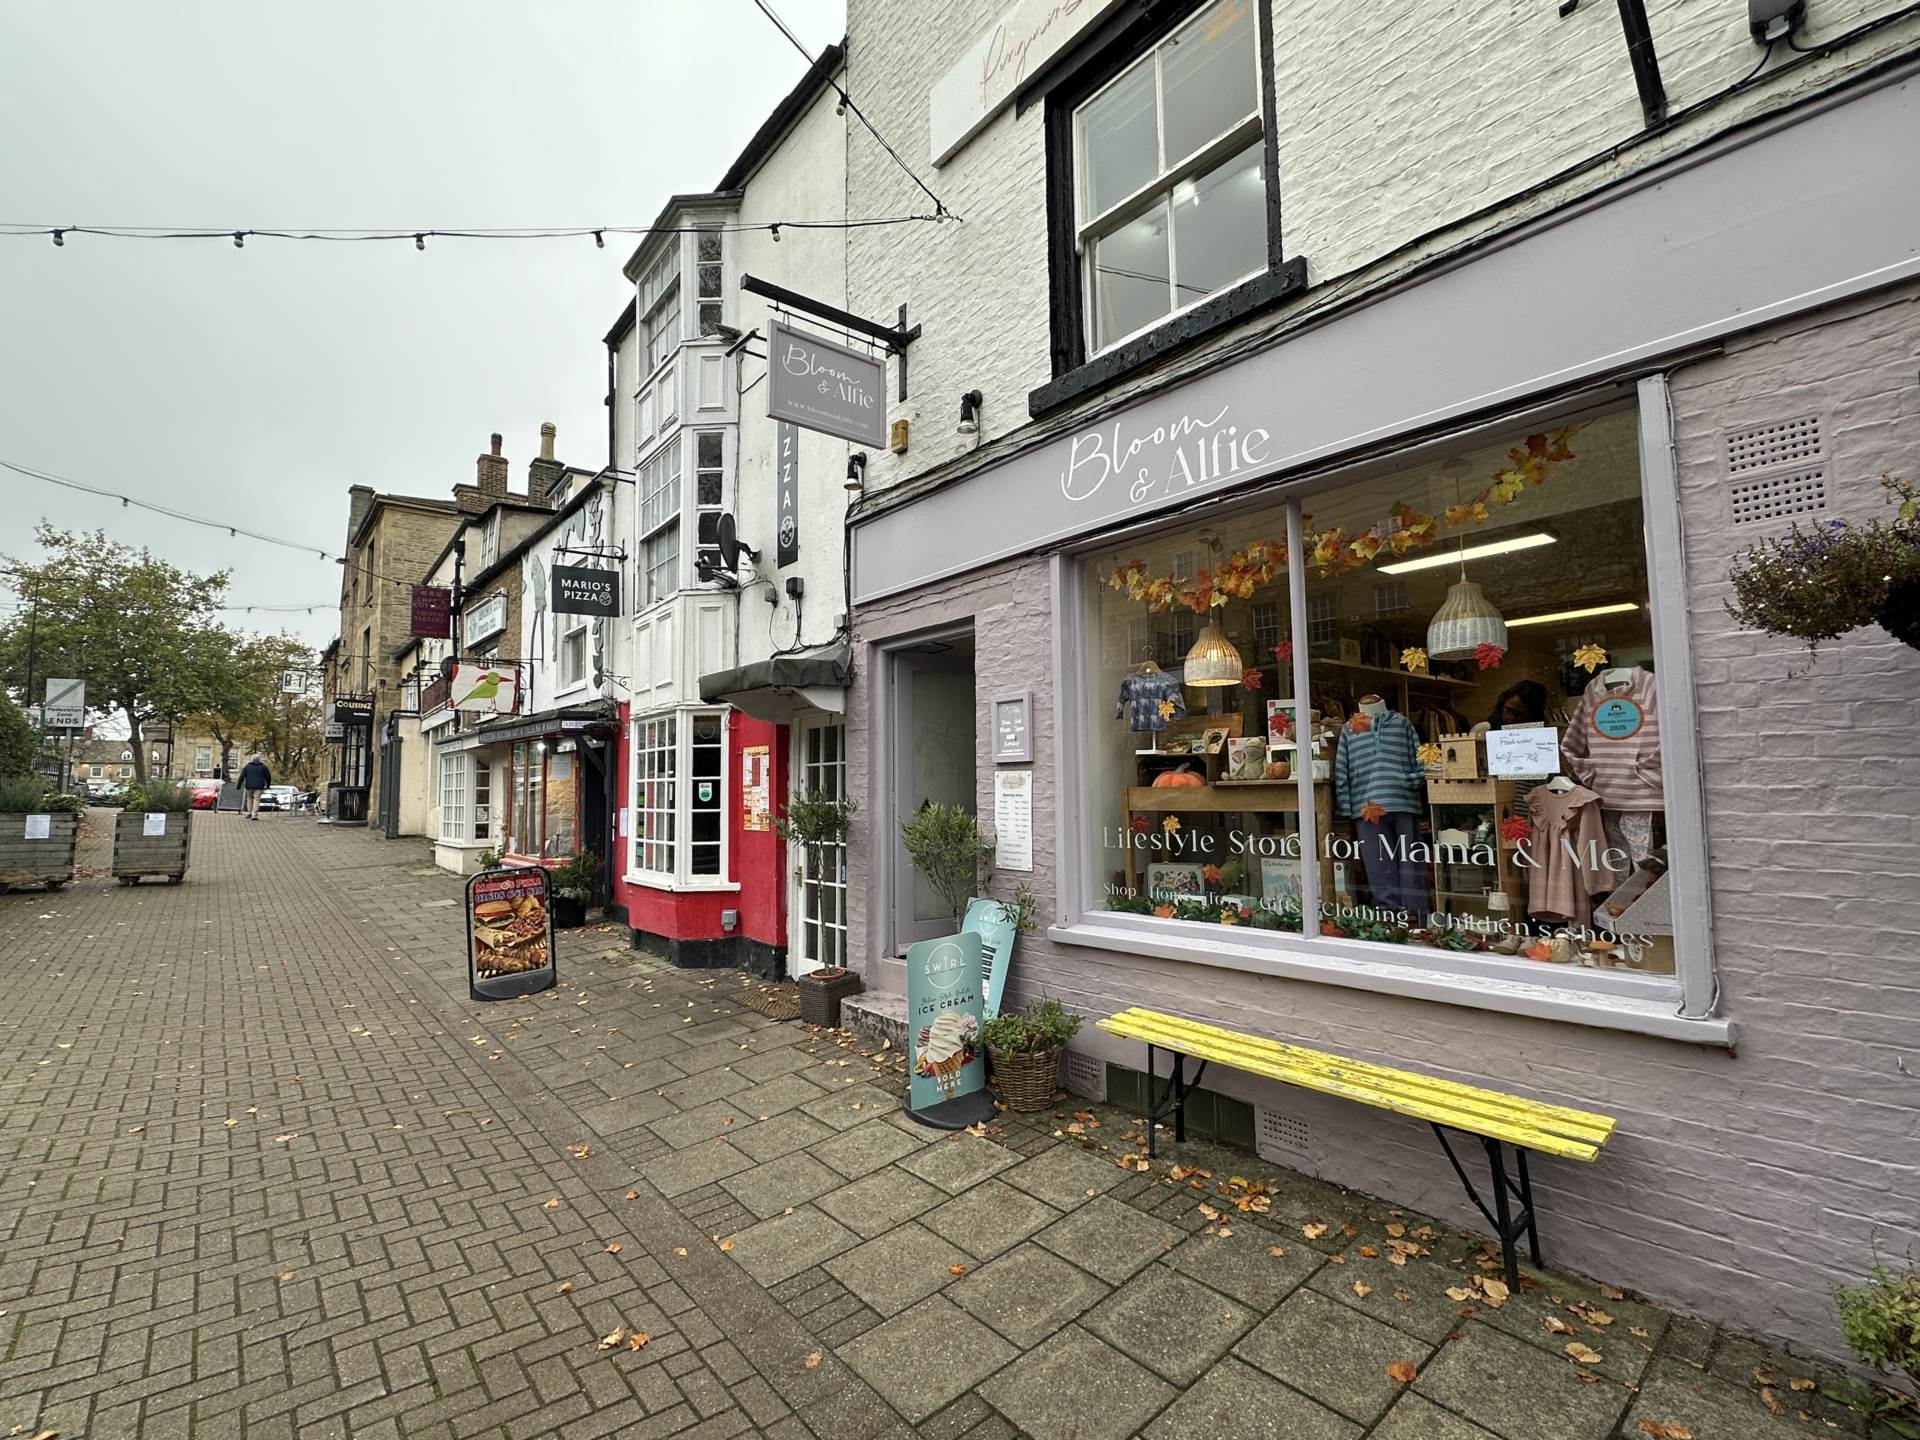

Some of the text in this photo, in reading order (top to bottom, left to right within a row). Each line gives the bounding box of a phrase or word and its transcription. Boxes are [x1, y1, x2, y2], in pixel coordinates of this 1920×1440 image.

[783, 343, 861, 384] Bloom
[817, 379, 874, 409] & Alfie
[1061, 404, 1230, 502] Bloom
[1130, 425, 1270, 503] & Alfie
[561, 578, 611, 592] MARIO'S
[564, 590, 599, 602] PIZZA
[336, 700, 373, 710] COUSINZ
[1103, 827, 1628, 872] Lifestyle Store for Mama & Me
[1103, 882, 1137, 900] Shop
[1322, 900, 1409, 928] Clothing
[1431, 911, 1551, 938] Children's
[918, 994, 974, 1015] ICE CREAM
[936, 1078, 962, 1093] HERE
[937, 1070, 961, 1083] SOLD
